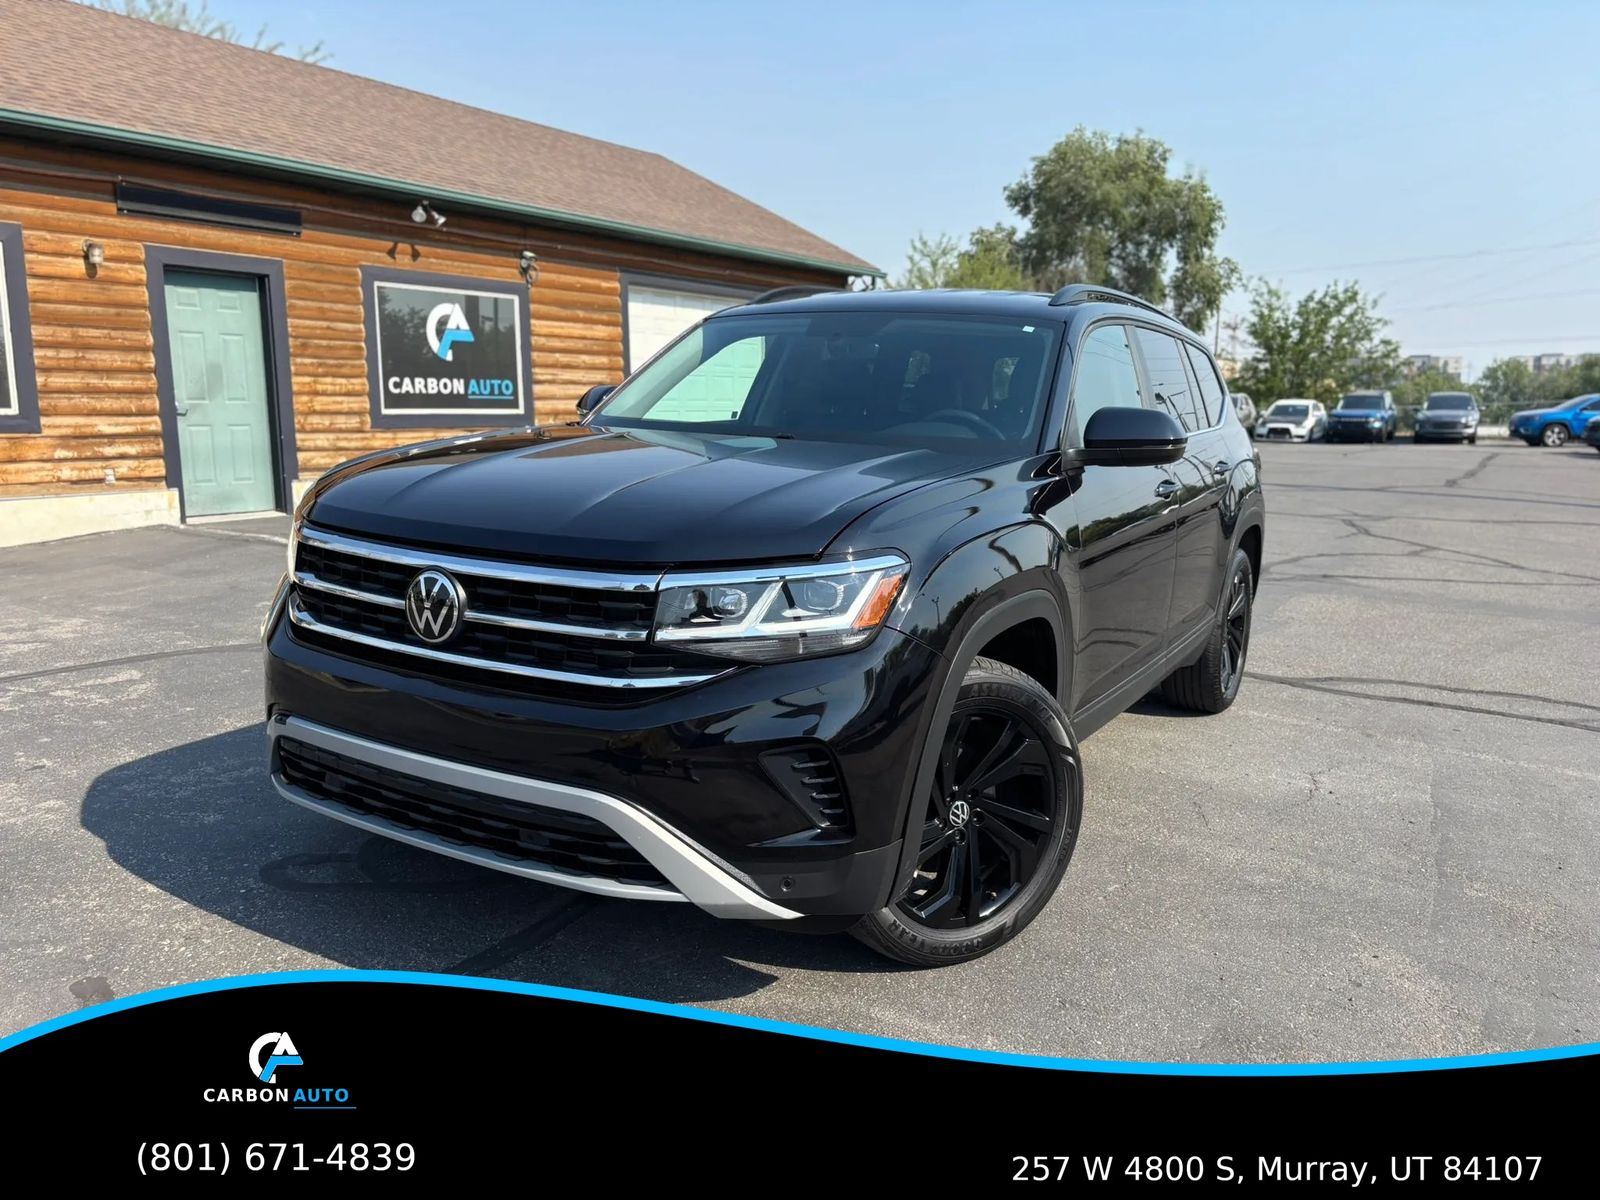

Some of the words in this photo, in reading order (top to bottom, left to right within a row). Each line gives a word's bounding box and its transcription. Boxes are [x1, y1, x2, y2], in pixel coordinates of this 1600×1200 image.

[388, 376, 465, 395] CARBON
[467, 378, 514, 396] AUTO
[407, 570, 458, 642] VW
